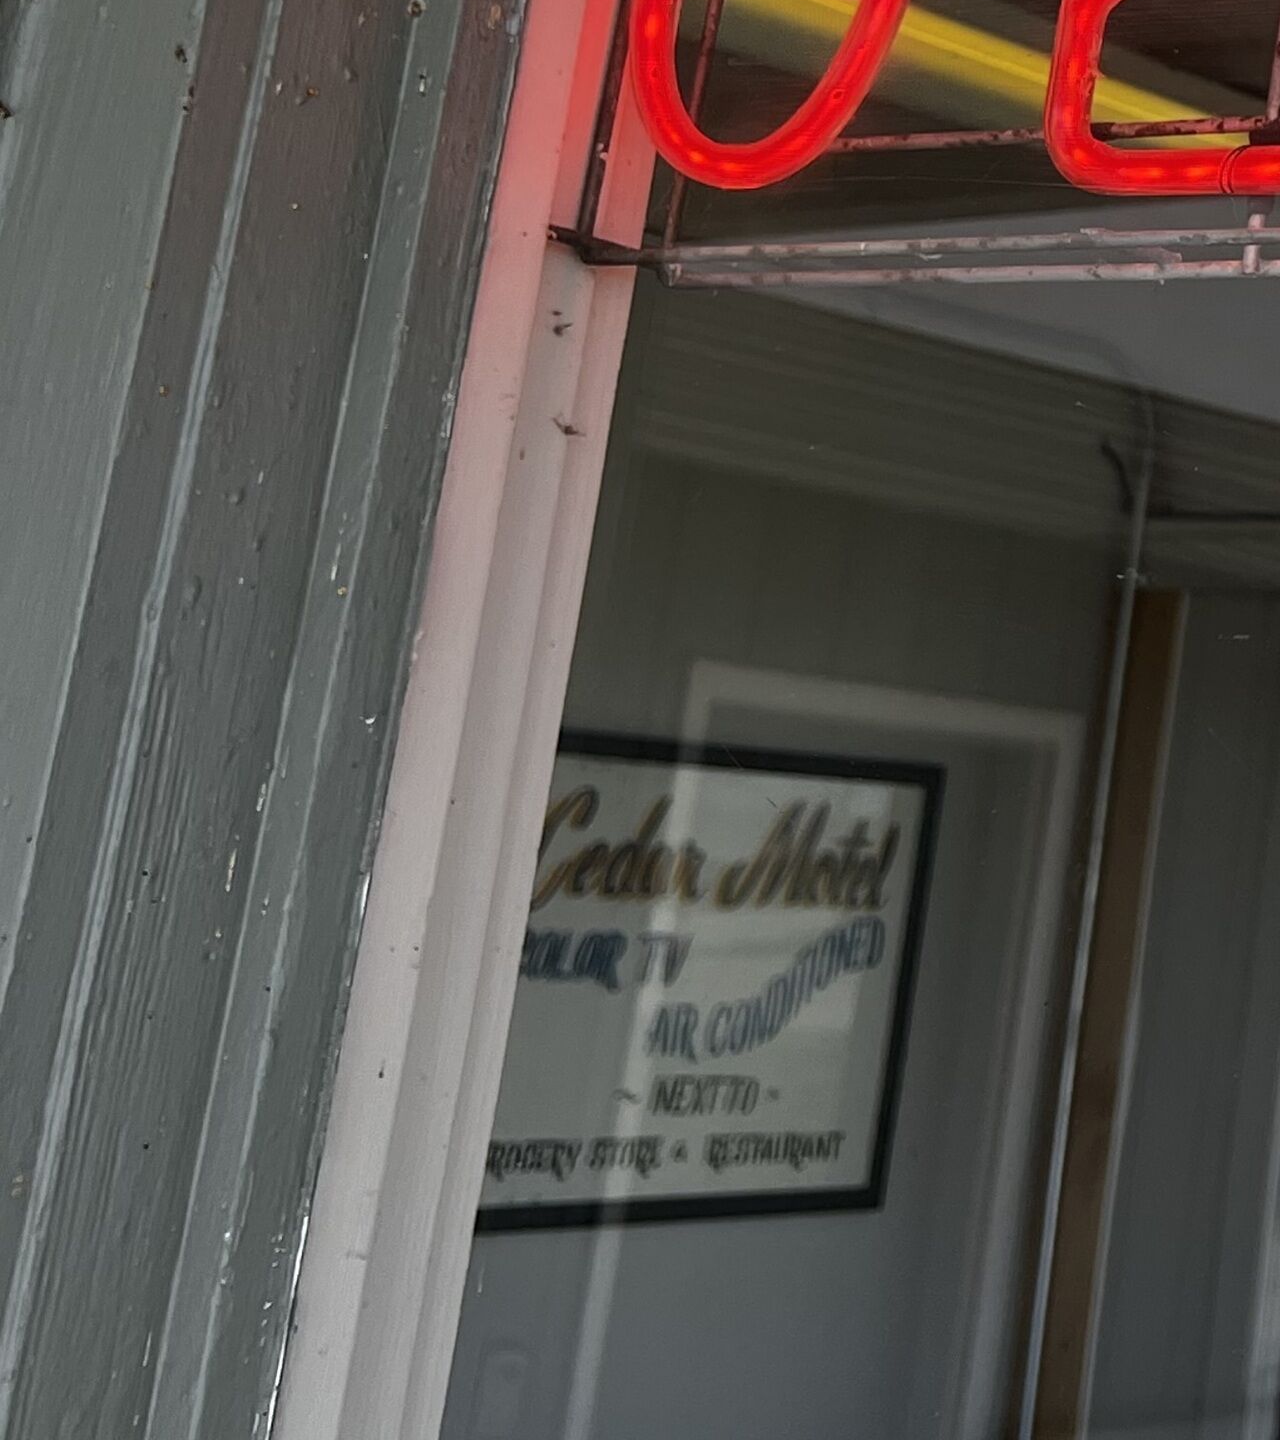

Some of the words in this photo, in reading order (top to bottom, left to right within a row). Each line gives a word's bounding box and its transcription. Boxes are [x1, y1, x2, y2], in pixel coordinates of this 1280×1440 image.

[529, 785, 707, 912] Cedar
[713, 798, 899, 912] Motel
[634, 930, 696, 988] TV
[645, 1000, 702, 1064] AIR
[703, 915, 886, 1058] CONDITIONED
[485, 1138, 583, 1183] ROCERY
[588, 1133, 666, 1180] STORE
[703, 1128, 848, 1175] RESTAURANT
